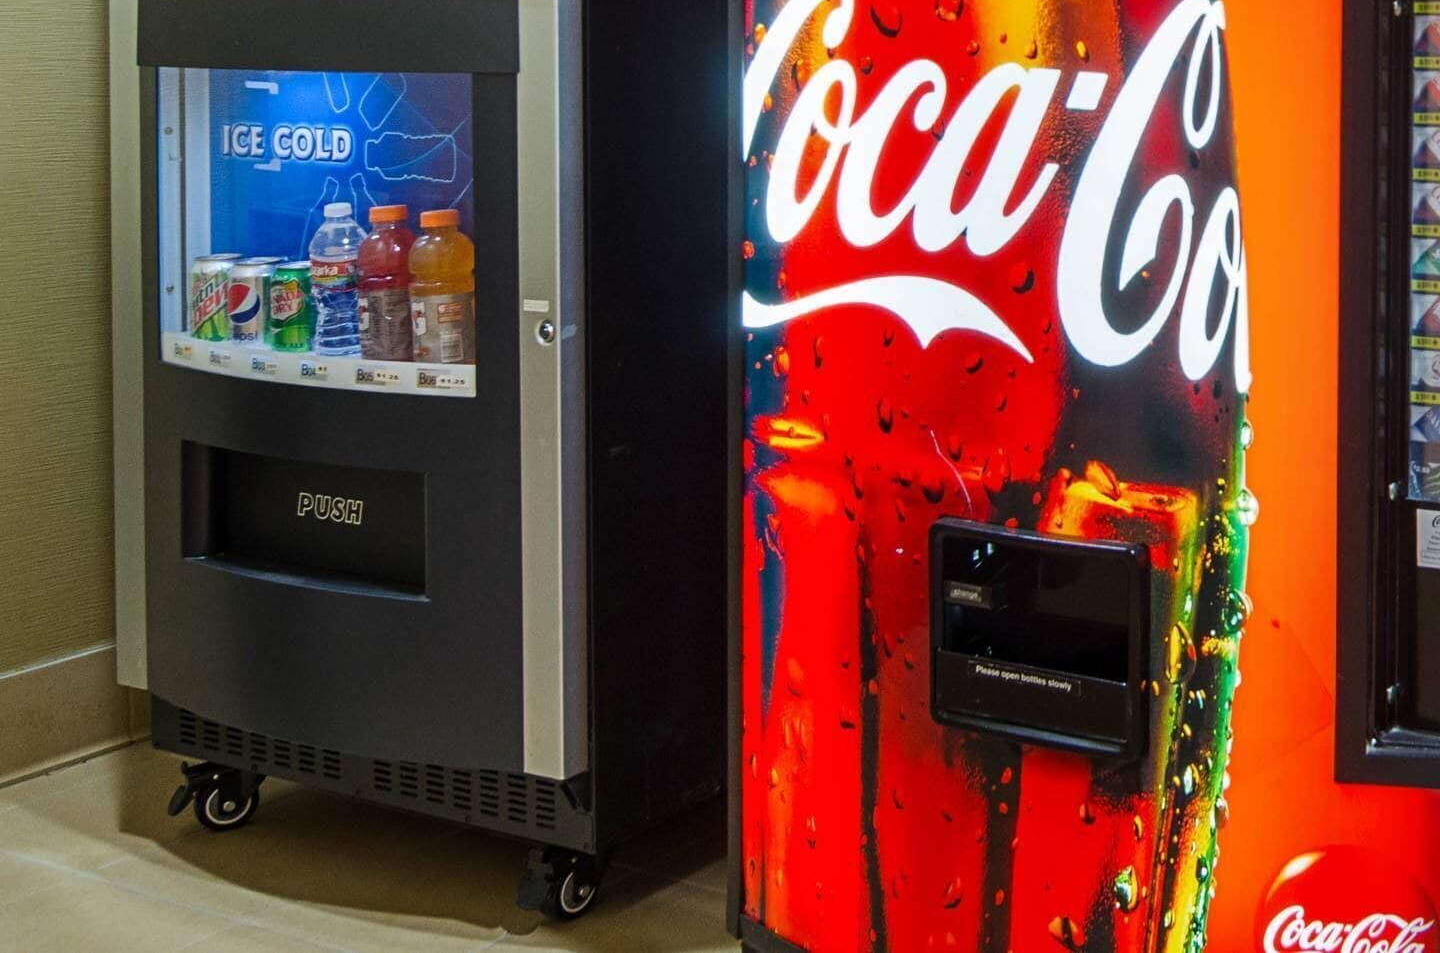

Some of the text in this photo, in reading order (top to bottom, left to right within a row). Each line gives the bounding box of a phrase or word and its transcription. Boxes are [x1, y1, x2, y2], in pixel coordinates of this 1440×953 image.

[222, 124, 352, 163] ICE COLD
[297, 492, 364, 525] PUSH
[975, 664, 1072, 693] Please open bottles slowly
[1263, 904, 1435, 953] Coca-Cola
